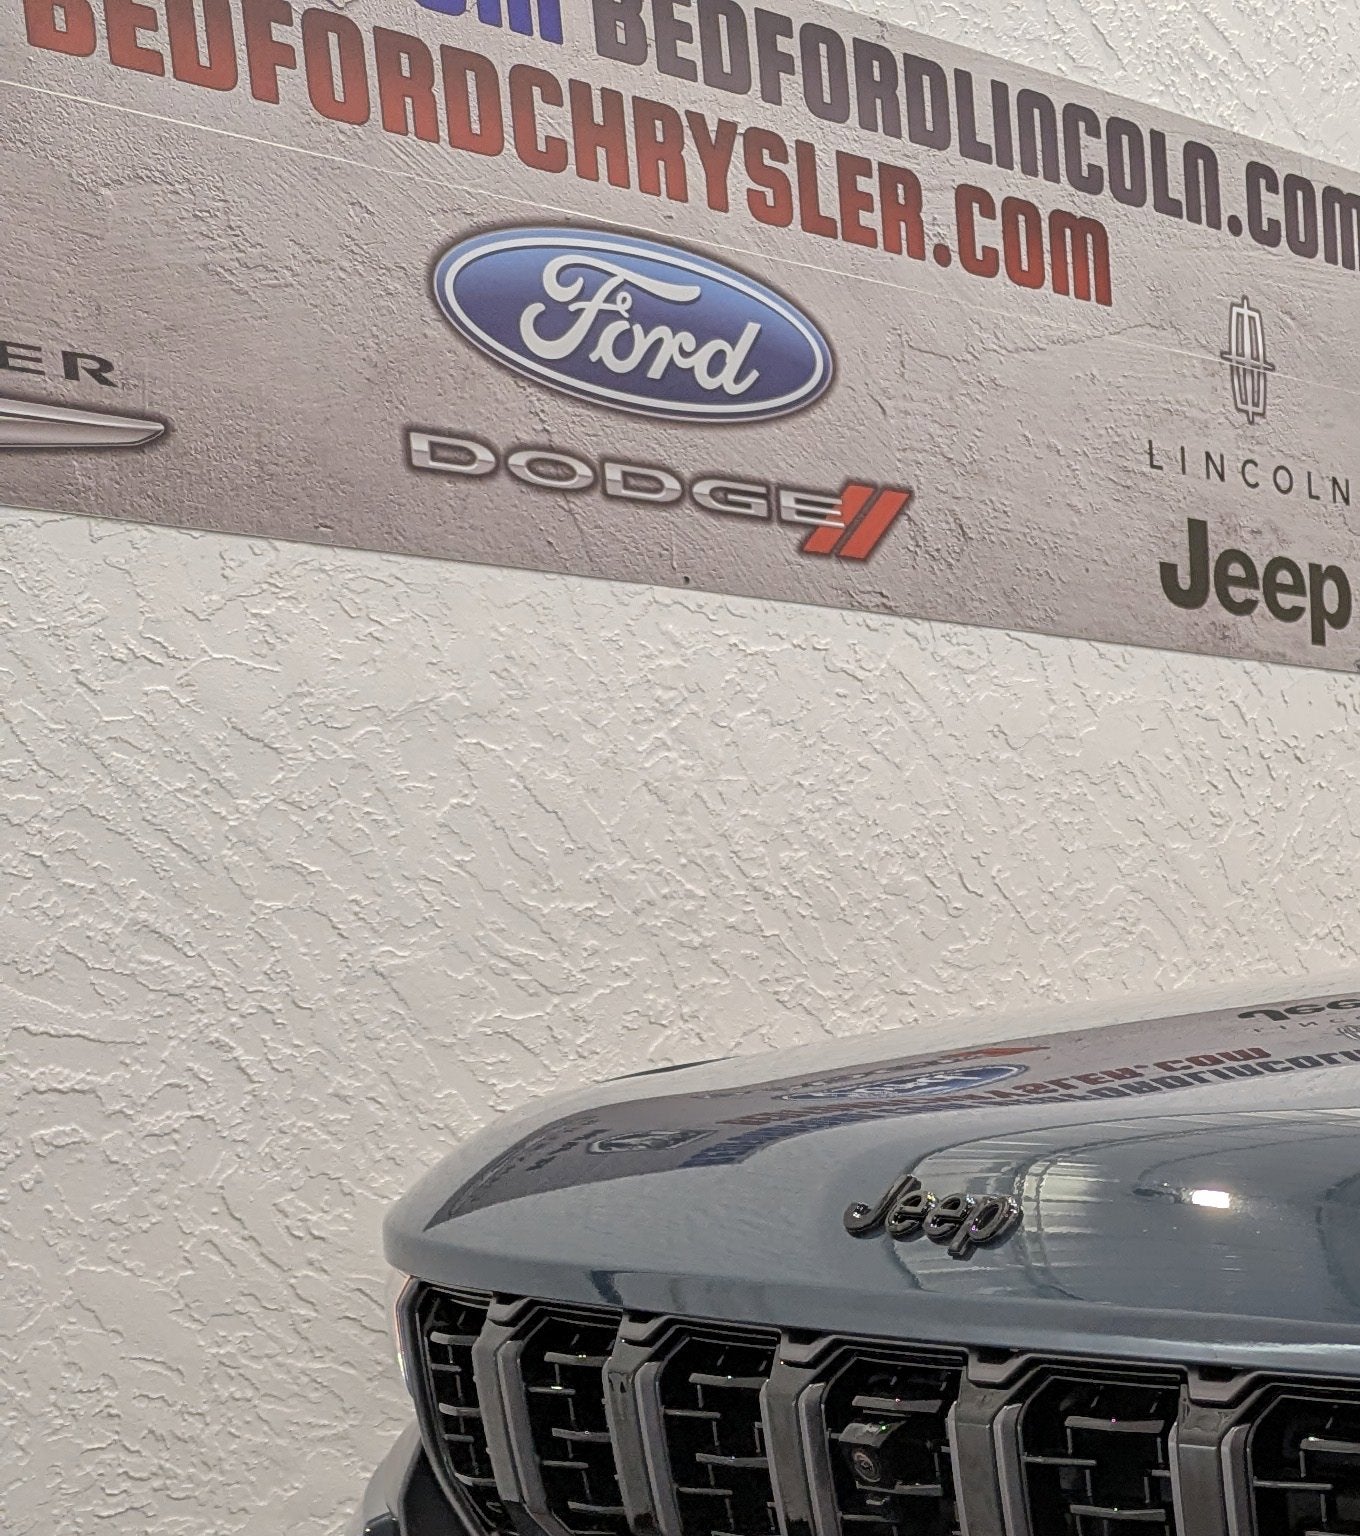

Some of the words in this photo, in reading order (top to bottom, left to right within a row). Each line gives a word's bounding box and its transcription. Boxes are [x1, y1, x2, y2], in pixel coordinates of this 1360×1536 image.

[519, 253, 761, 396] Ford
[407, 431, 846, 530] DODGE
[1148, 440, 1351, 507] LINCOLN
[1159, 518, 1352, 646] Jeep
[843, 1173, 1024, 1261] Jeep
